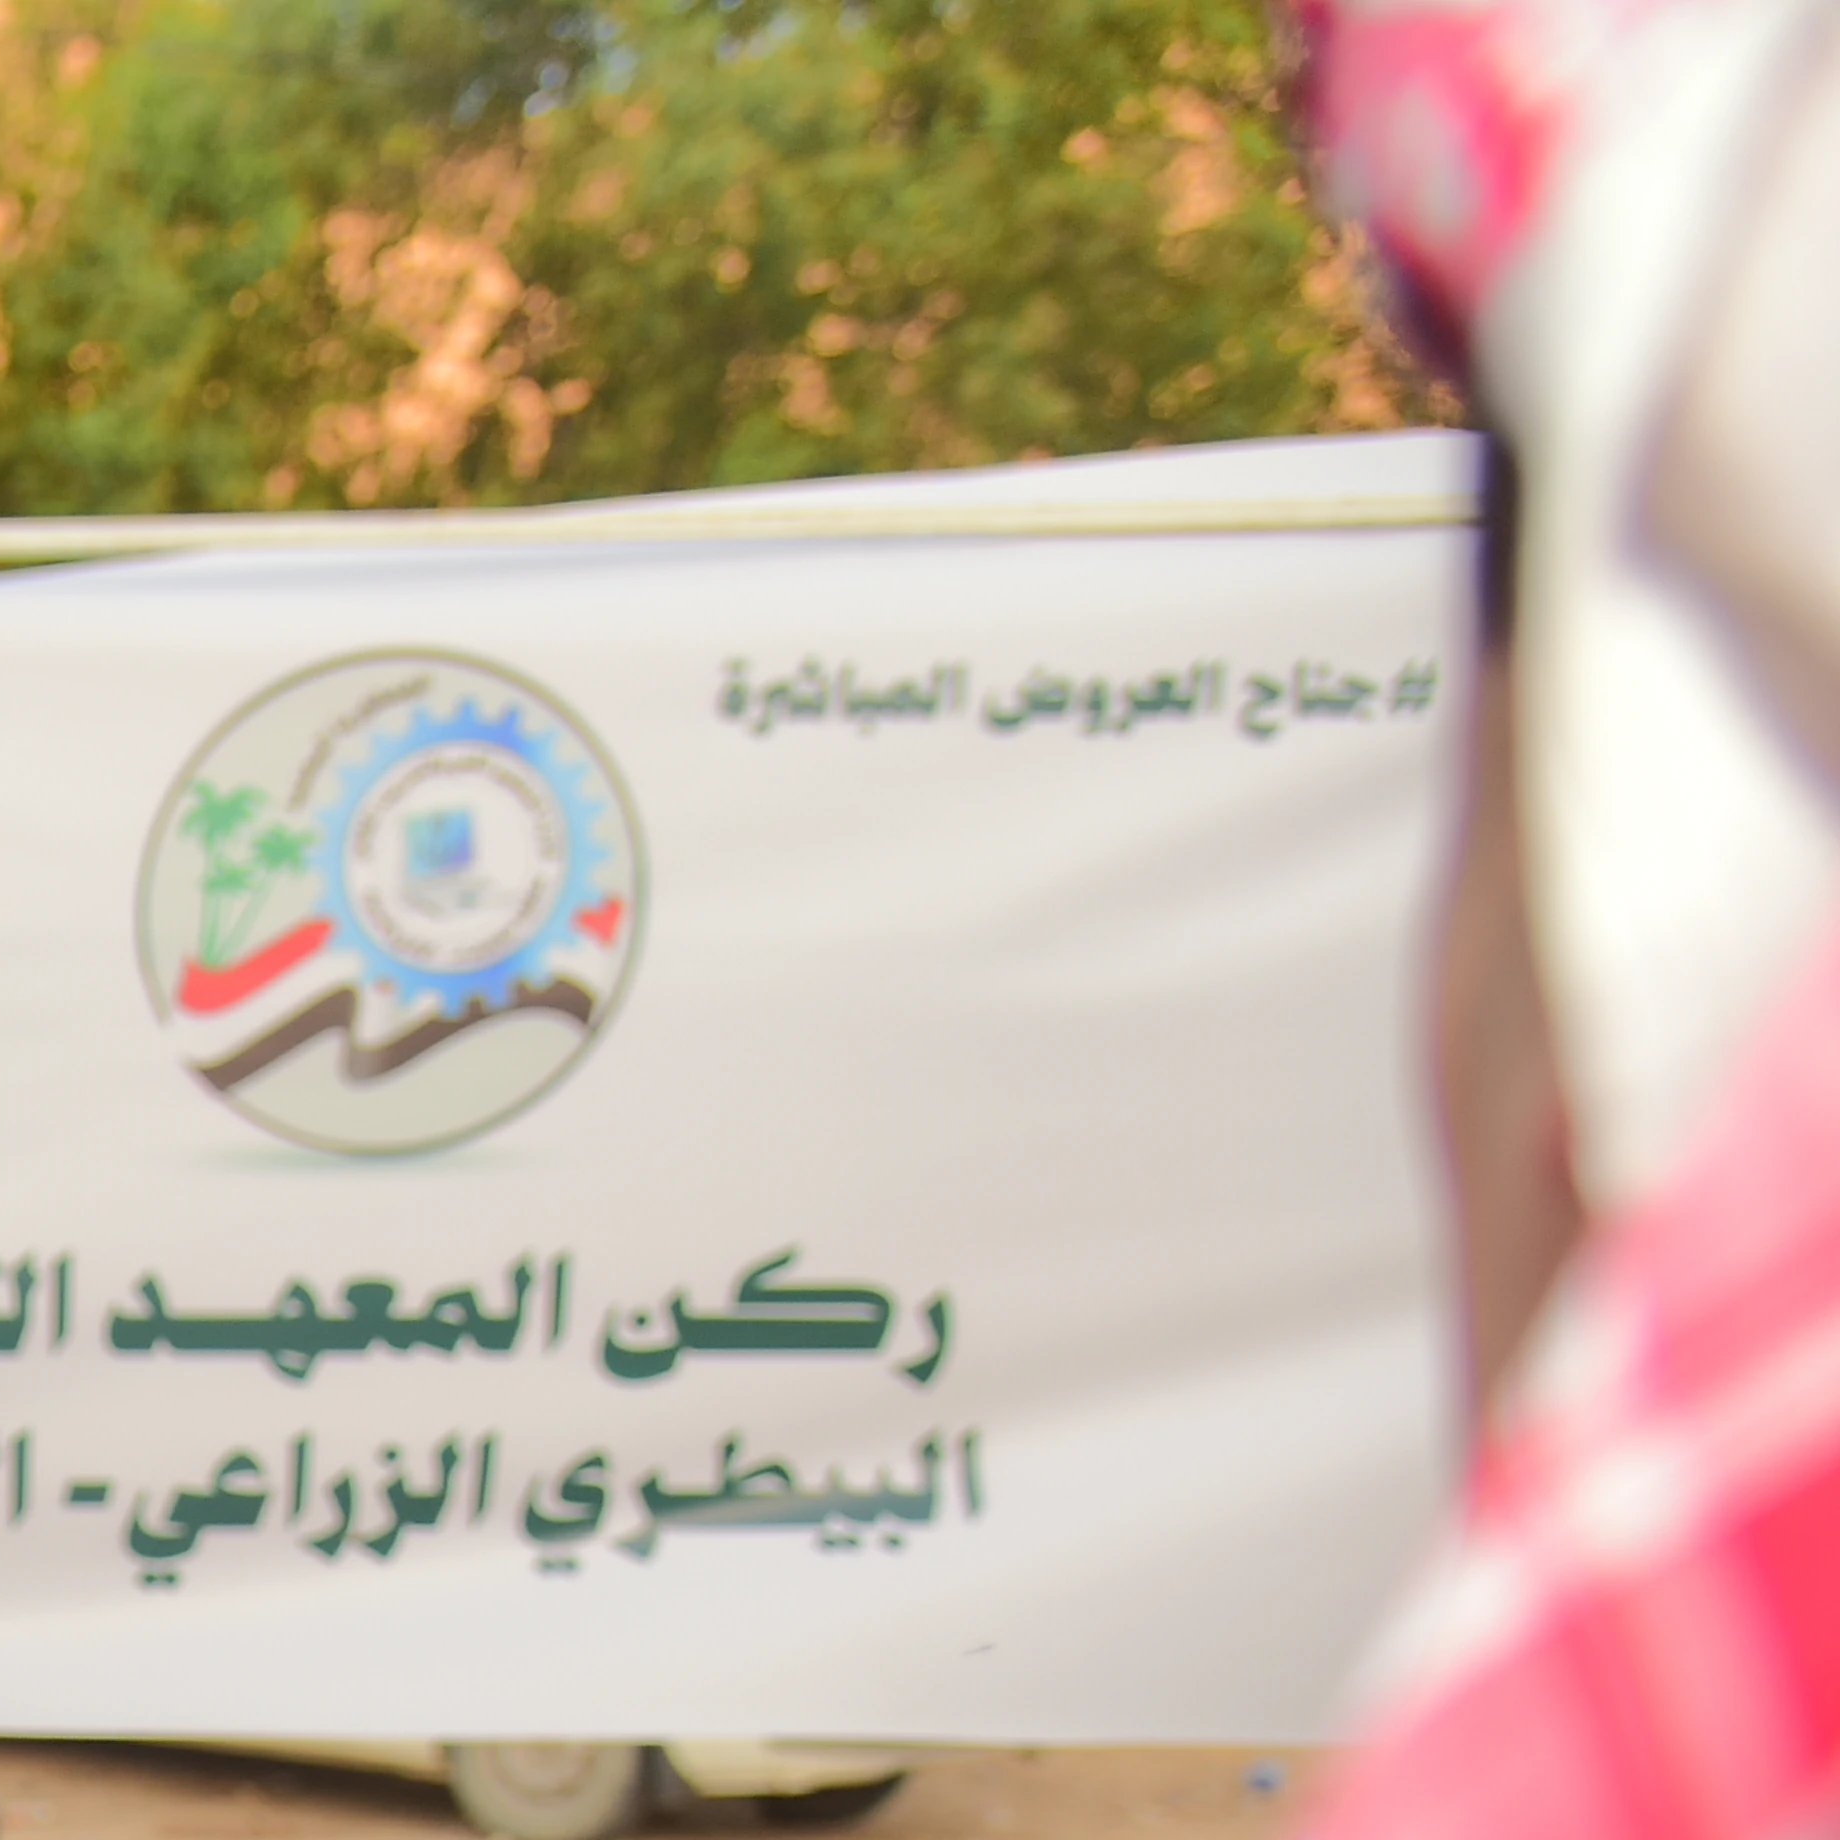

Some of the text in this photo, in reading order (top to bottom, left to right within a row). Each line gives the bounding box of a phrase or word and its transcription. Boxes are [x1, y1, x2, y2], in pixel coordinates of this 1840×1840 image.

[719, 654, 1440, 740] #جناح العروض المباشرة
[108, 1252, 573, 1382] المعهد
[601, 1248, 958, 1386] ركن
[523, 1431, 986, 1572] البيطري
